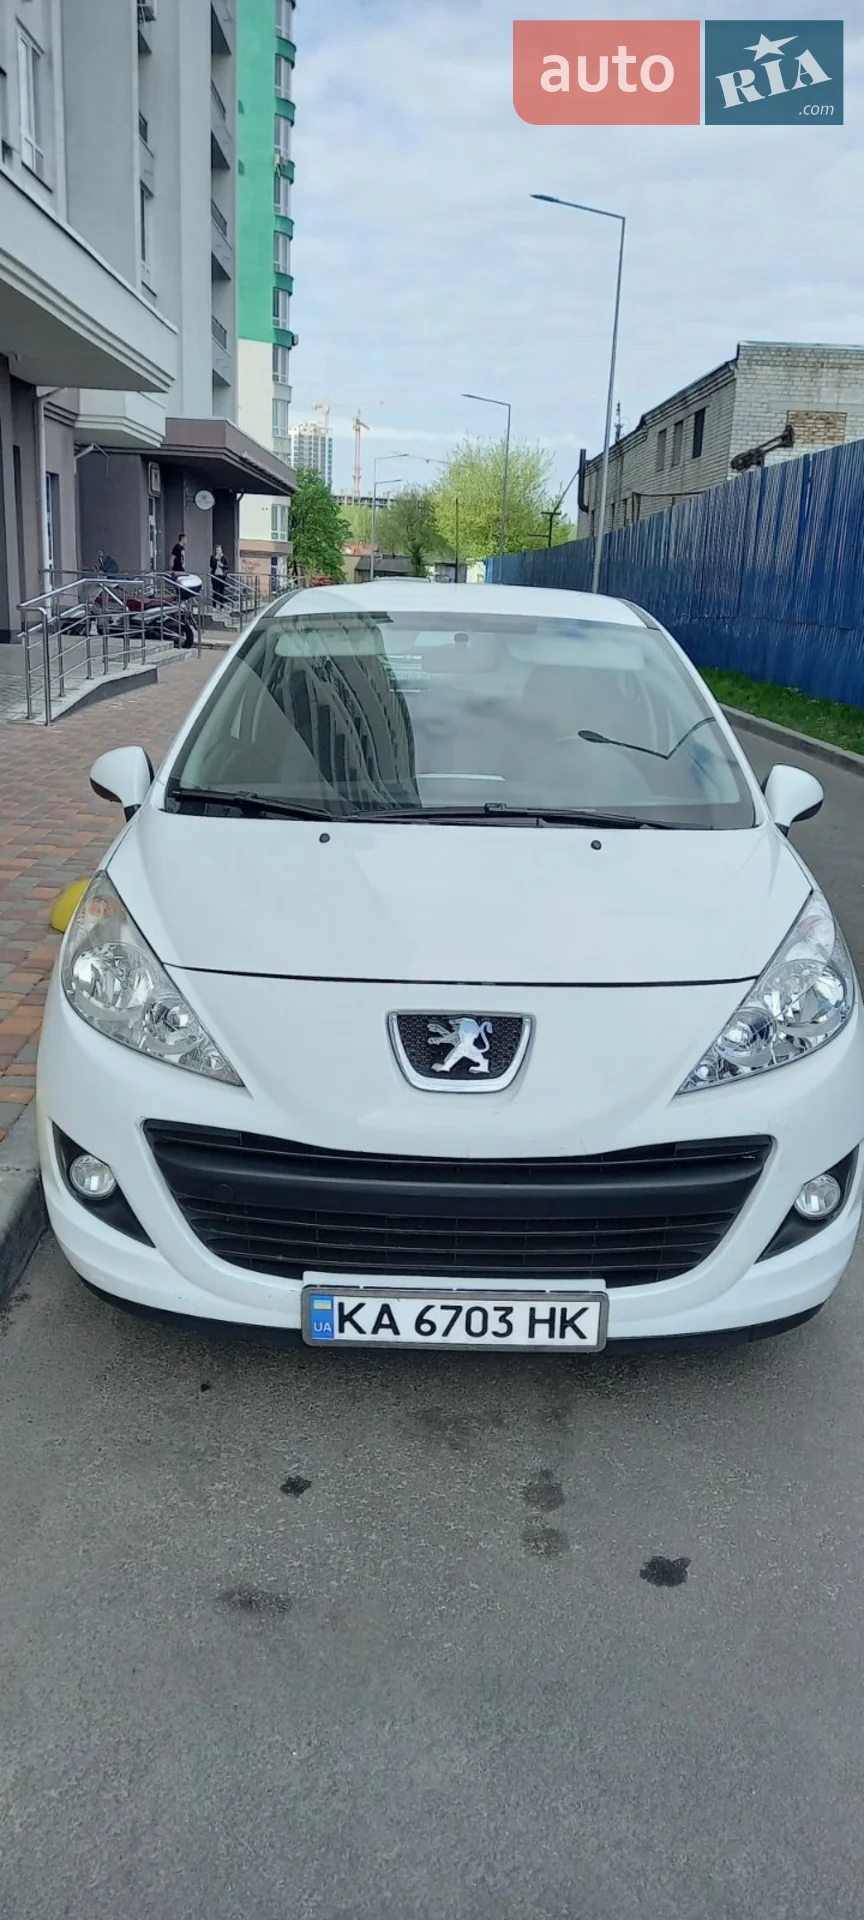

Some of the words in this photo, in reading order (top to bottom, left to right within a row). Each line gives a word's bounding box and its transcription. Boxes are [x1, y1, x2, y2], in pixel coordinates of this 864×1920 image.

[314, 1322, 331, 1332] UA
[337, 1302, 400, 1335] KA
[414, 1305, 513, 1338] 6703
[528, 1307, 589, 1339] HK
